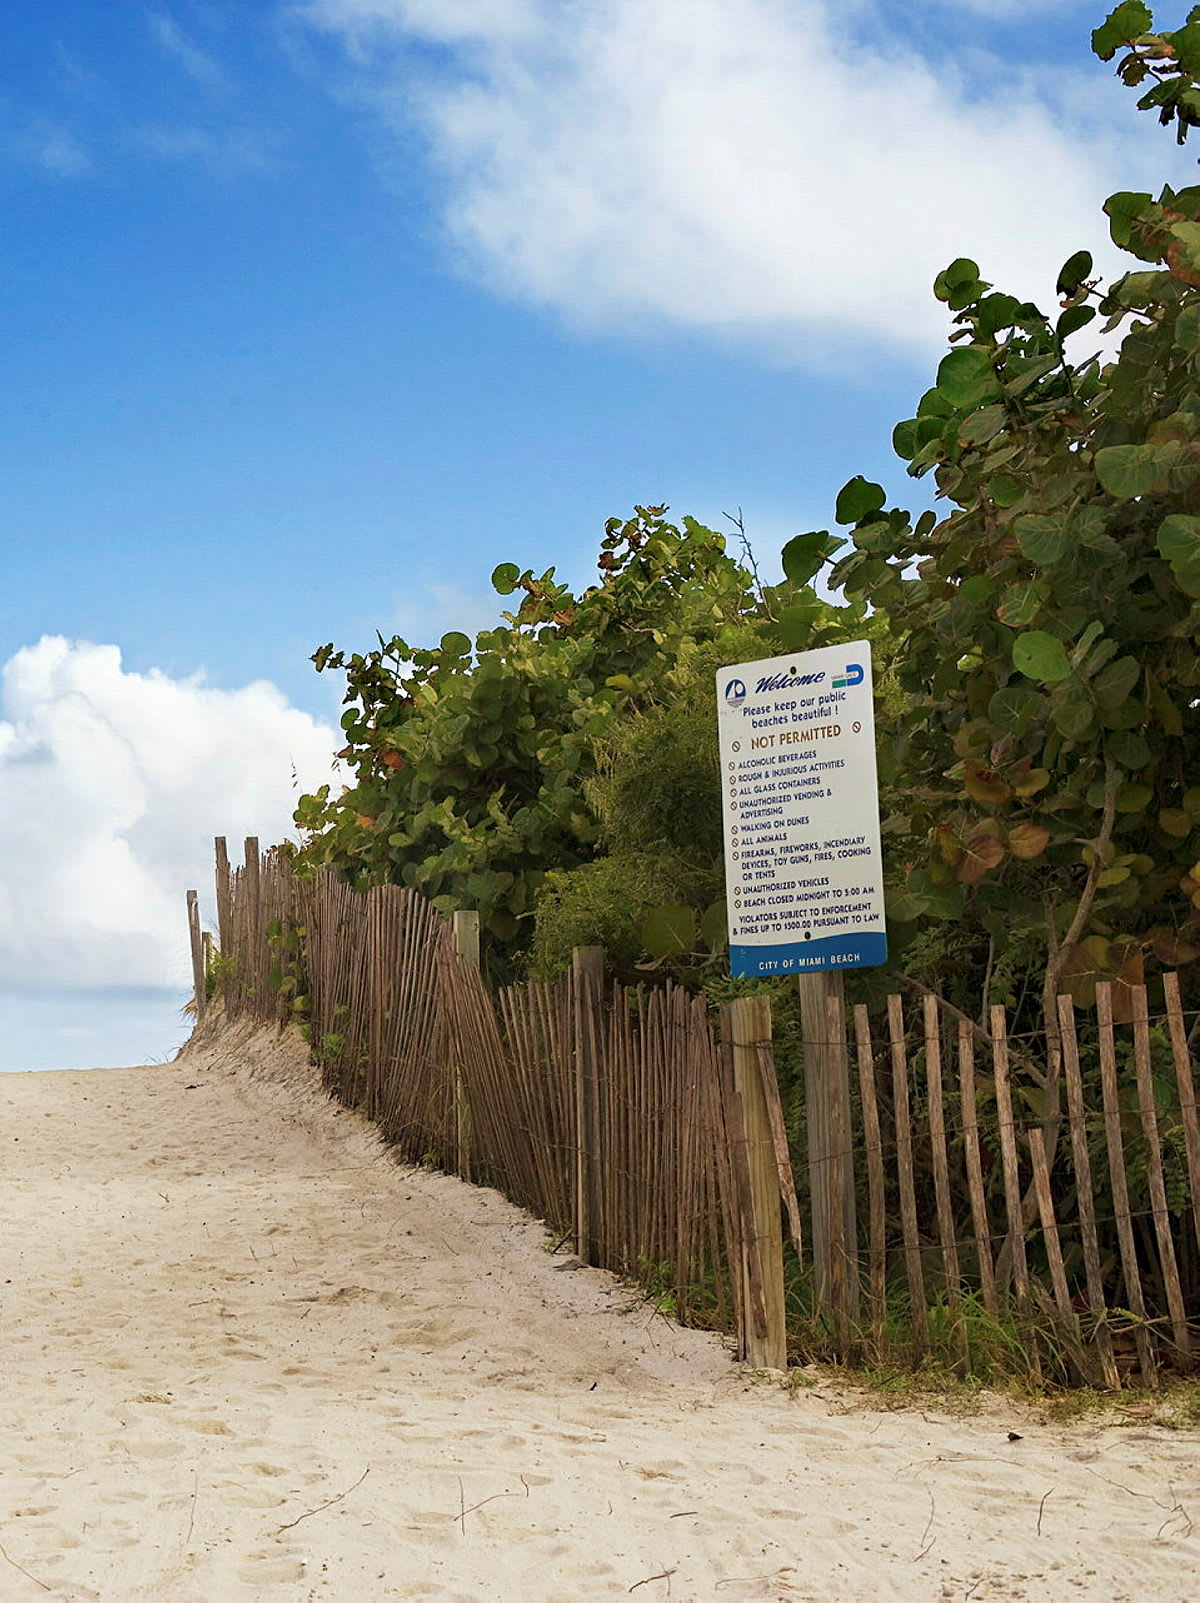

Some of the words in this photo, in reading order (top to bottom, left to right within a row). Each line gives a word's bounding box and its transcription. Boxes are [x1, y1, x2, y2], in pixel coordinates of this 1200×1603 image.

[755, 672, 825, 693] Welcome
[743, 704, 770, 717] Please
[775, 701, 796, 711] keep
[800, 698, 815, 706] our
[819, 691, 846, 704] public
[752, 714, 788, 728] beaches
[792, 706, 831, 721] beautiful
[835, 705, 838, 715] !
[751, 735, 775, 749] NOT
[780, 725, 841, 745] PERMITTED
[738, 756, 776, 769] ALCOHOLIC
[778, 751, 816, 763] BEVERAGES
[739, 772, 762, 782] ROUGH
[772, 765, 807, 777] INJURIOUS
[810, 759, 845, 772] ACTIVITIES
[739, 787, 752, 795] ALL
[754, 782, 776, 793] GLASS
[778, 777, 821, 789] CONTAINERS
[740, 794, 791, 809] UNAUTHORIZED
[794, 790, 824, 800] VENDING
[740, 807, 783, 819] ADVERTISING
[741, 821, 771, 832] WALKING
[774, 819, 784, 827] ON
[787, 816, 809, 826] DUNES
[741, 837, 753, 845] ALL
[756, 833, 787, 843] ANIMALS
[741, 849, 777, 859] FIREARMS,
[780, 841, 821, 854] FIREWORKS,
[824, 836, 865, 848] INCENDIARY
[742, 859, 771, 870] DEVICES,
[774, 857, 788, 866] TOY
[790, 854, 811, 864] GUNS,
[814, 852, 835, 861] FIRES,
[838, 847, 871, 858] COOKING
[742, 872, 752, 880] OR
[755, 870, 775, 879] TENTS
[743, 881, 796, 894] UNAUTHORIZED
[798, 877, 829, 887] VEHICLES
[744, 896, 765, 907] BEACH
[768, 893, 794, 904] CLOSED
[796, 890, 830, 901] MIDNIGHT
[833, 889, 842, 897] TO
[844, 888, 860, 896] 5:00
[739, 912, 777, 923] VIOLATORS
[780, 909, 807, 919] SUBJECT
[810, 908, 819, 916] TO
[822, 902, 871, 915] ENFORCEMENT
[733, 928, 738, 936] &
[741, 924, 758, 935] FINES
[761, 923, 770, 933] UP
[772, 922, 781, 931] TO
[814, 916, 850, 927] PURSUANT
[852, 914, 861, 923] TO
[864, 913, 880, 922] LAW
[759, 961, 778, 970] CITY
[783, 960, 794, 968] OF
[799, 956, 825, 967] MIAMI
[831, 953, 860, 964] BEACH
